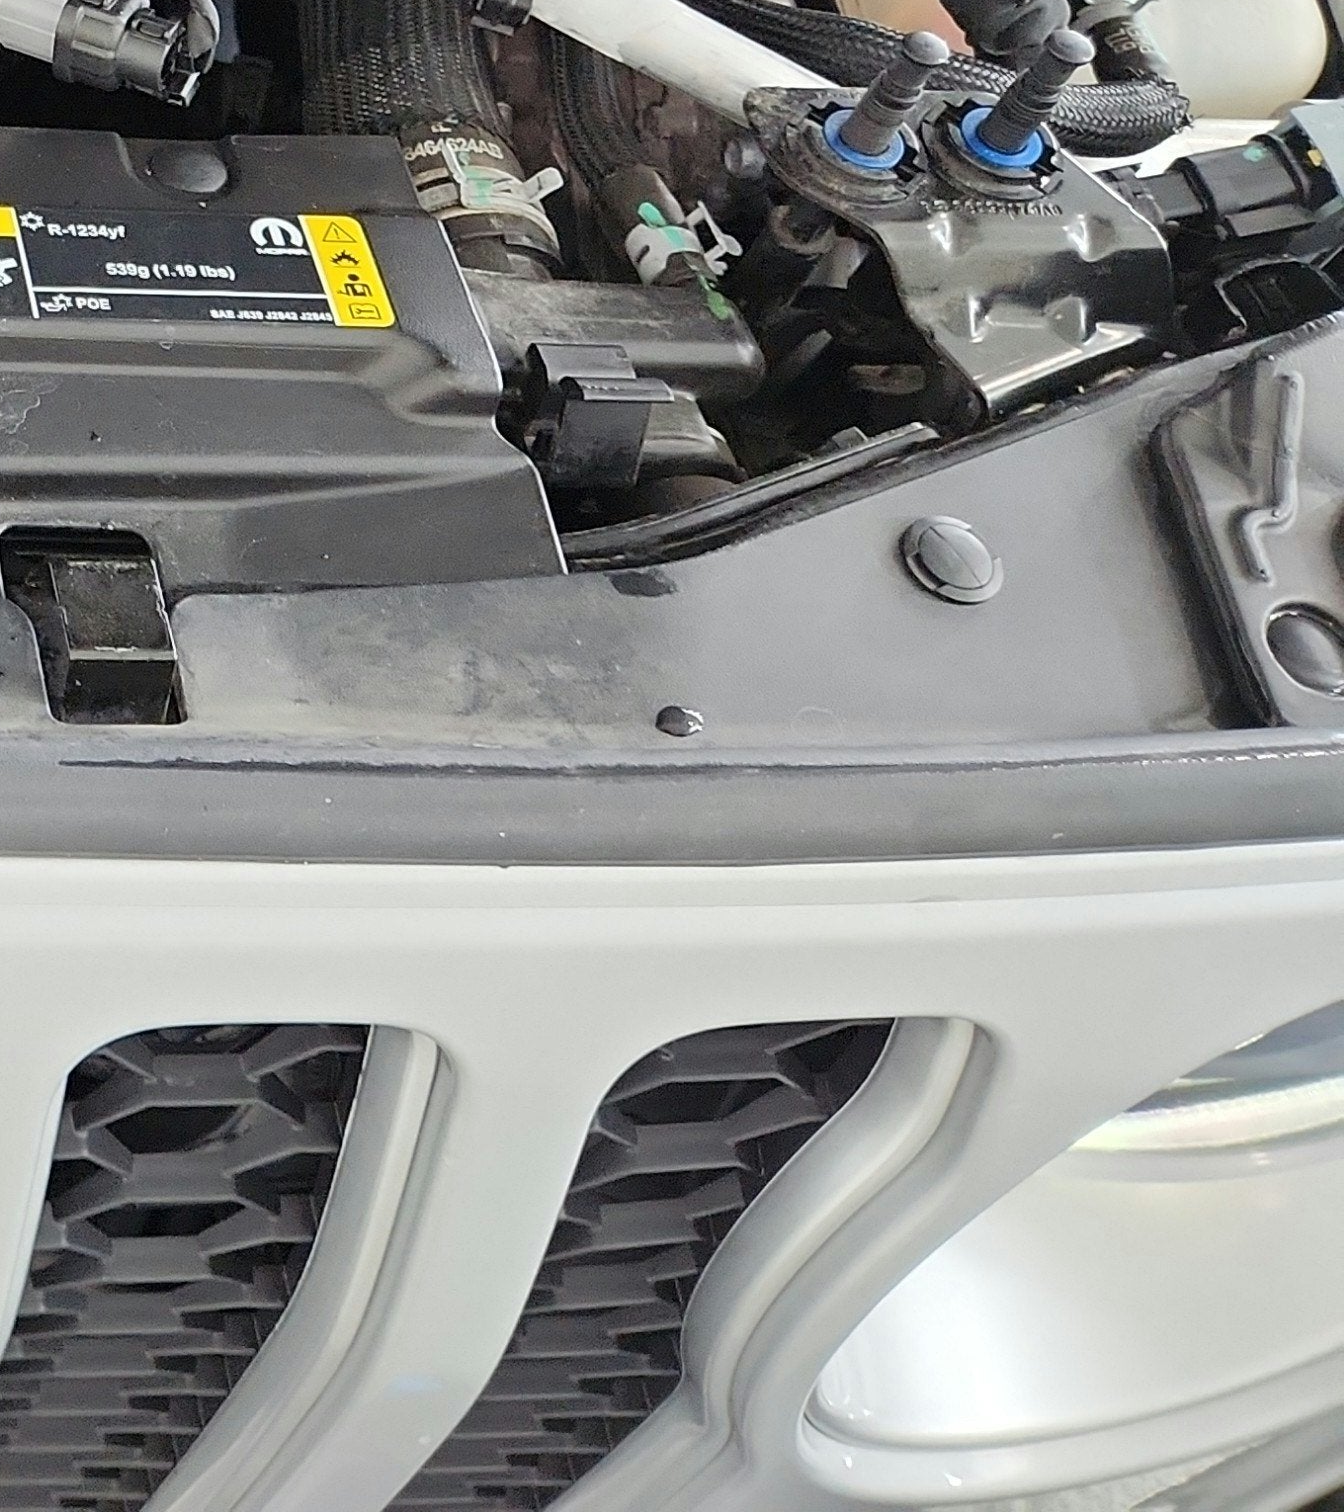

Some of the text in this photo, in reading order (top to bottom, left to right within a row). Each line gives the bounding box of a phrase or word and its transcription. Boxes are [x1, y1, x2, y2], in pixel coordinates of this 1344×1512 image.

[46, 223, 127, 241] R-1234yf
[105, 261, 236, 282] 539g (1.19 lbs)
[75, 296, 112, 311] POE
[209, 309, 236, 320] SAE
